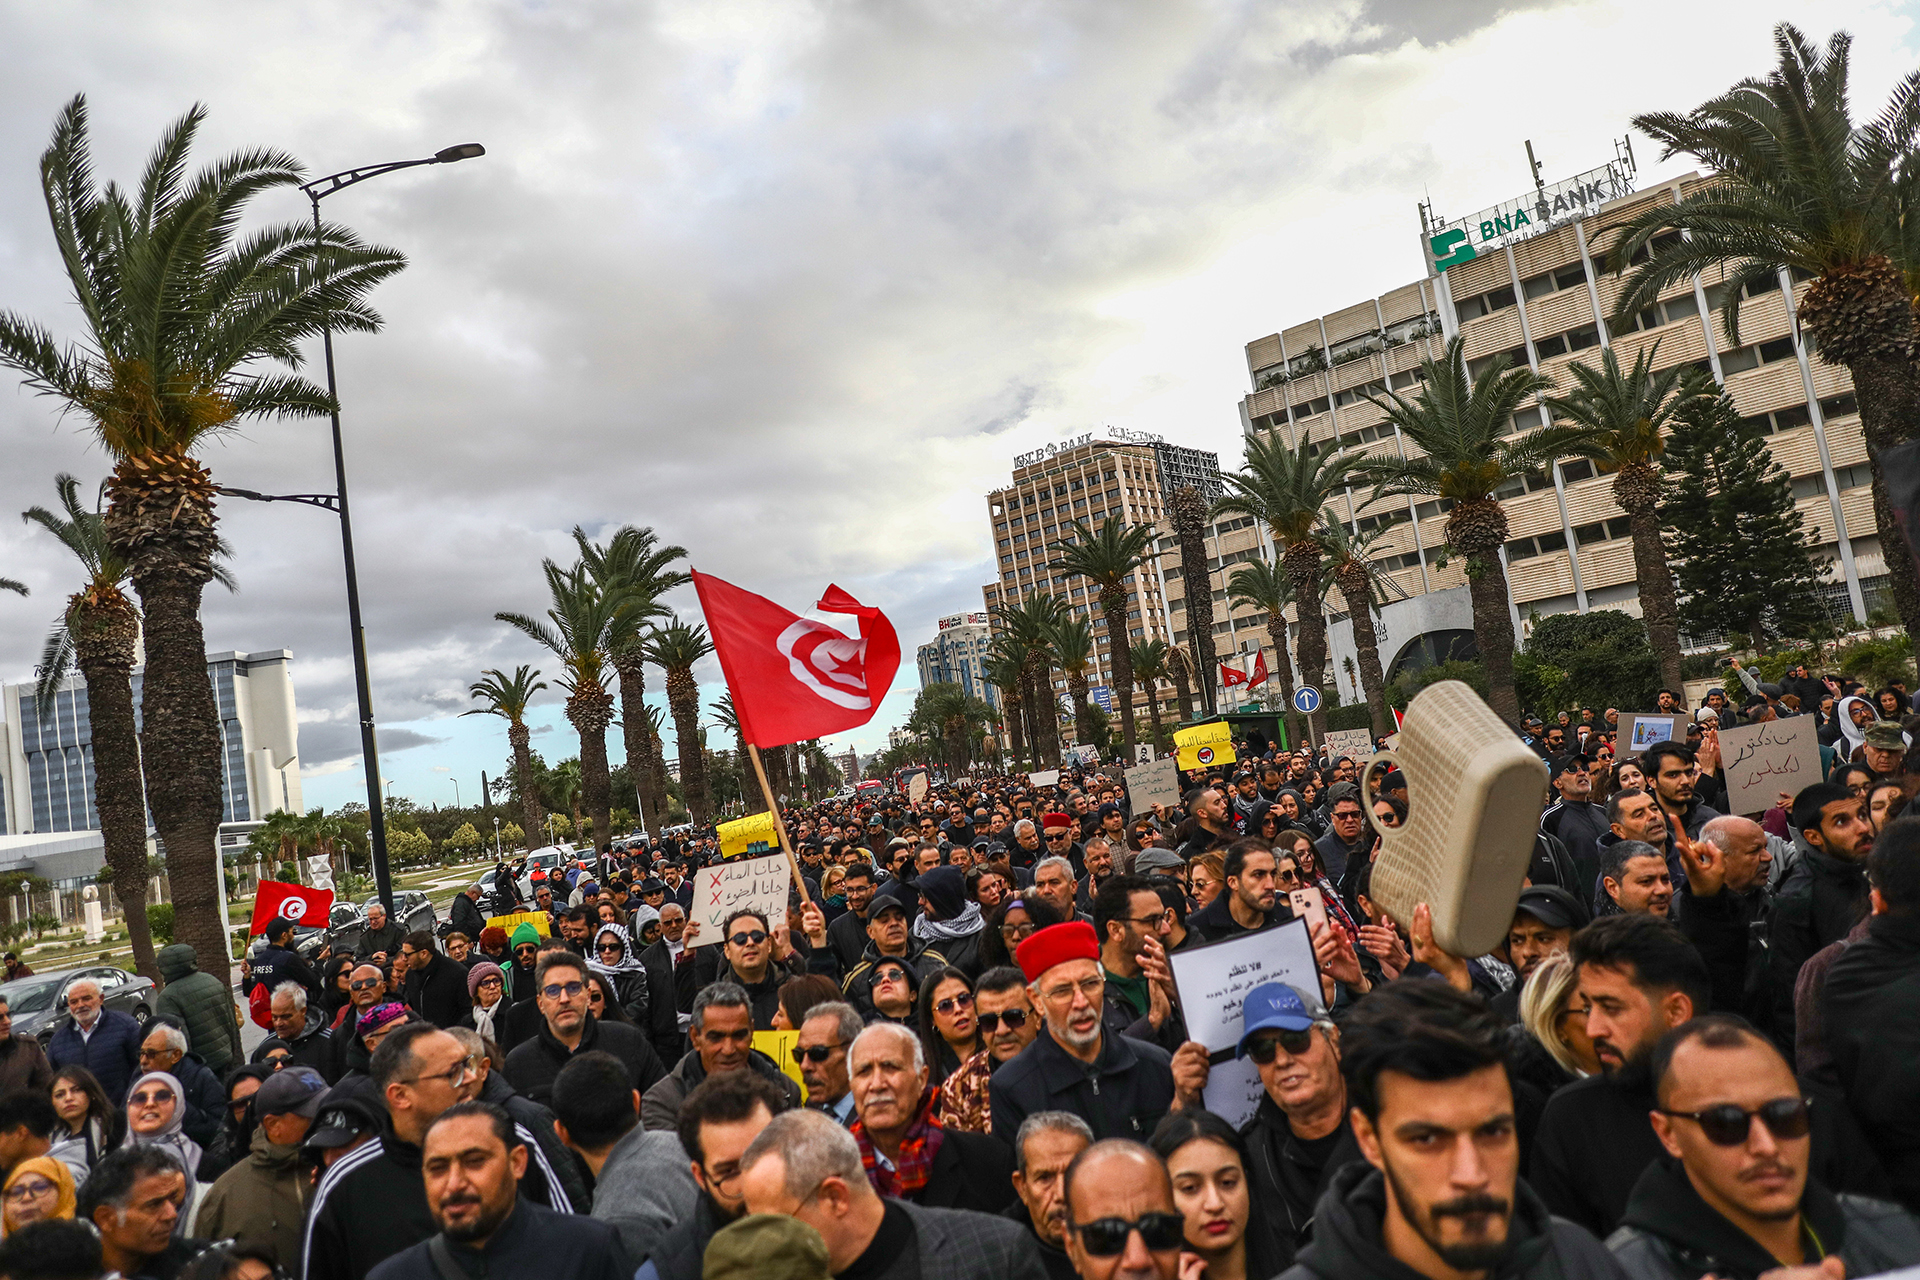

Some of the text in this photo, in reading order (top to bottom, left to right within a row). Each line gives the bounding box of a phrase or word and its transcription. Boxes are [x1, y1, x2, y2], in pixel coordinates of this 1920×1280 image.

[1480, 208, 1531, 241] BNA
[1535, 179, 1607, 220] BANK
[1060, 432, 1092, 452] BANK
[939, 619, 950, 630] BH
[724, 859, 782, 882] جانا الماء
[761, 879, 783, 895] جانا
[253, 964, 274, 974] PRESS
